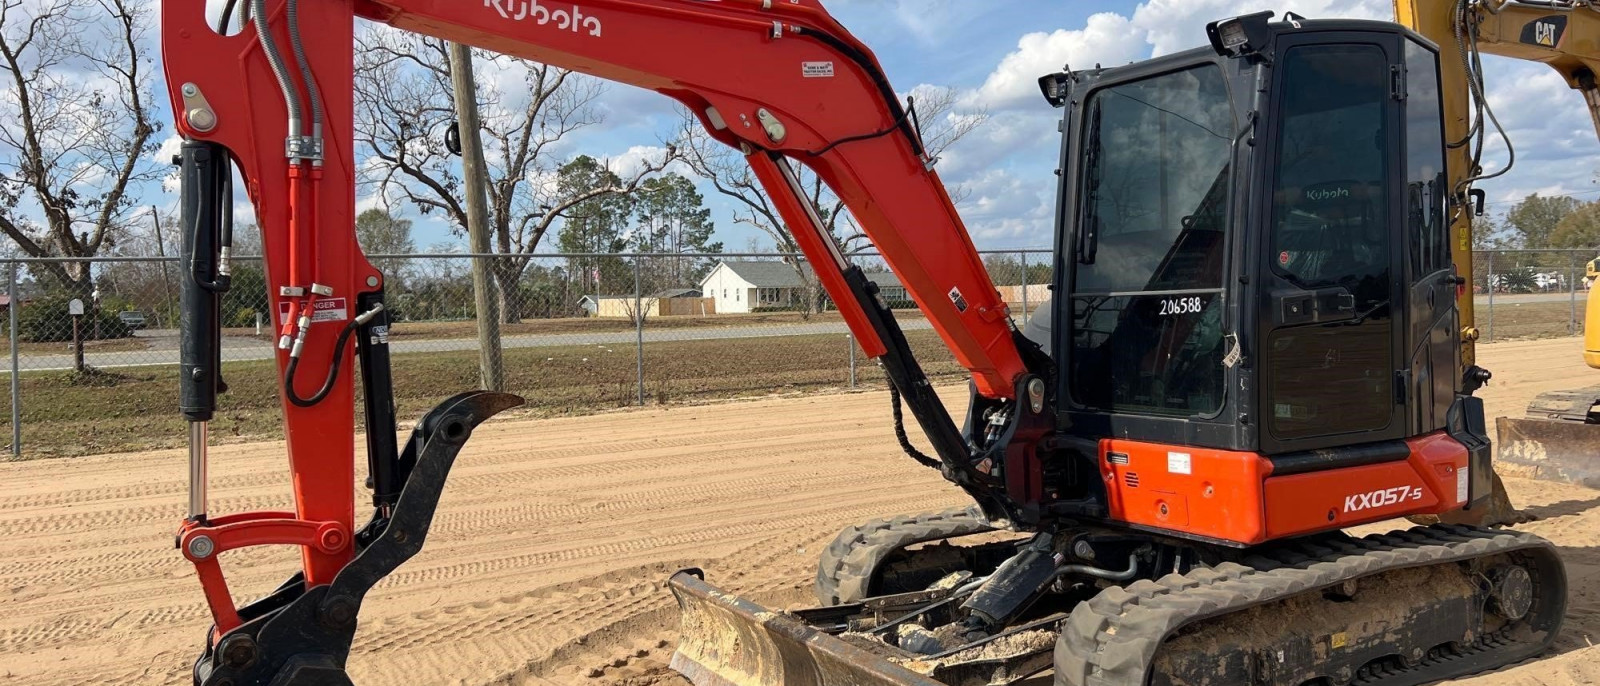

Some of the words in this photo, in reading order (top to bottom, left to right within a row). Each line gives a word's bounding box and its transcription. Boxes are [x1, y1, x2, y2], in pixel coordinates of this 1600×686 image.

[1535, 21, 1556, 46] CAT
[1306, 187, 1349, 200] Kubota
[301, 301, 336, 310] DNGER
[1159, 297, 1201, 315] 206588
[1343, 485, 1422, 513] KX057-5
